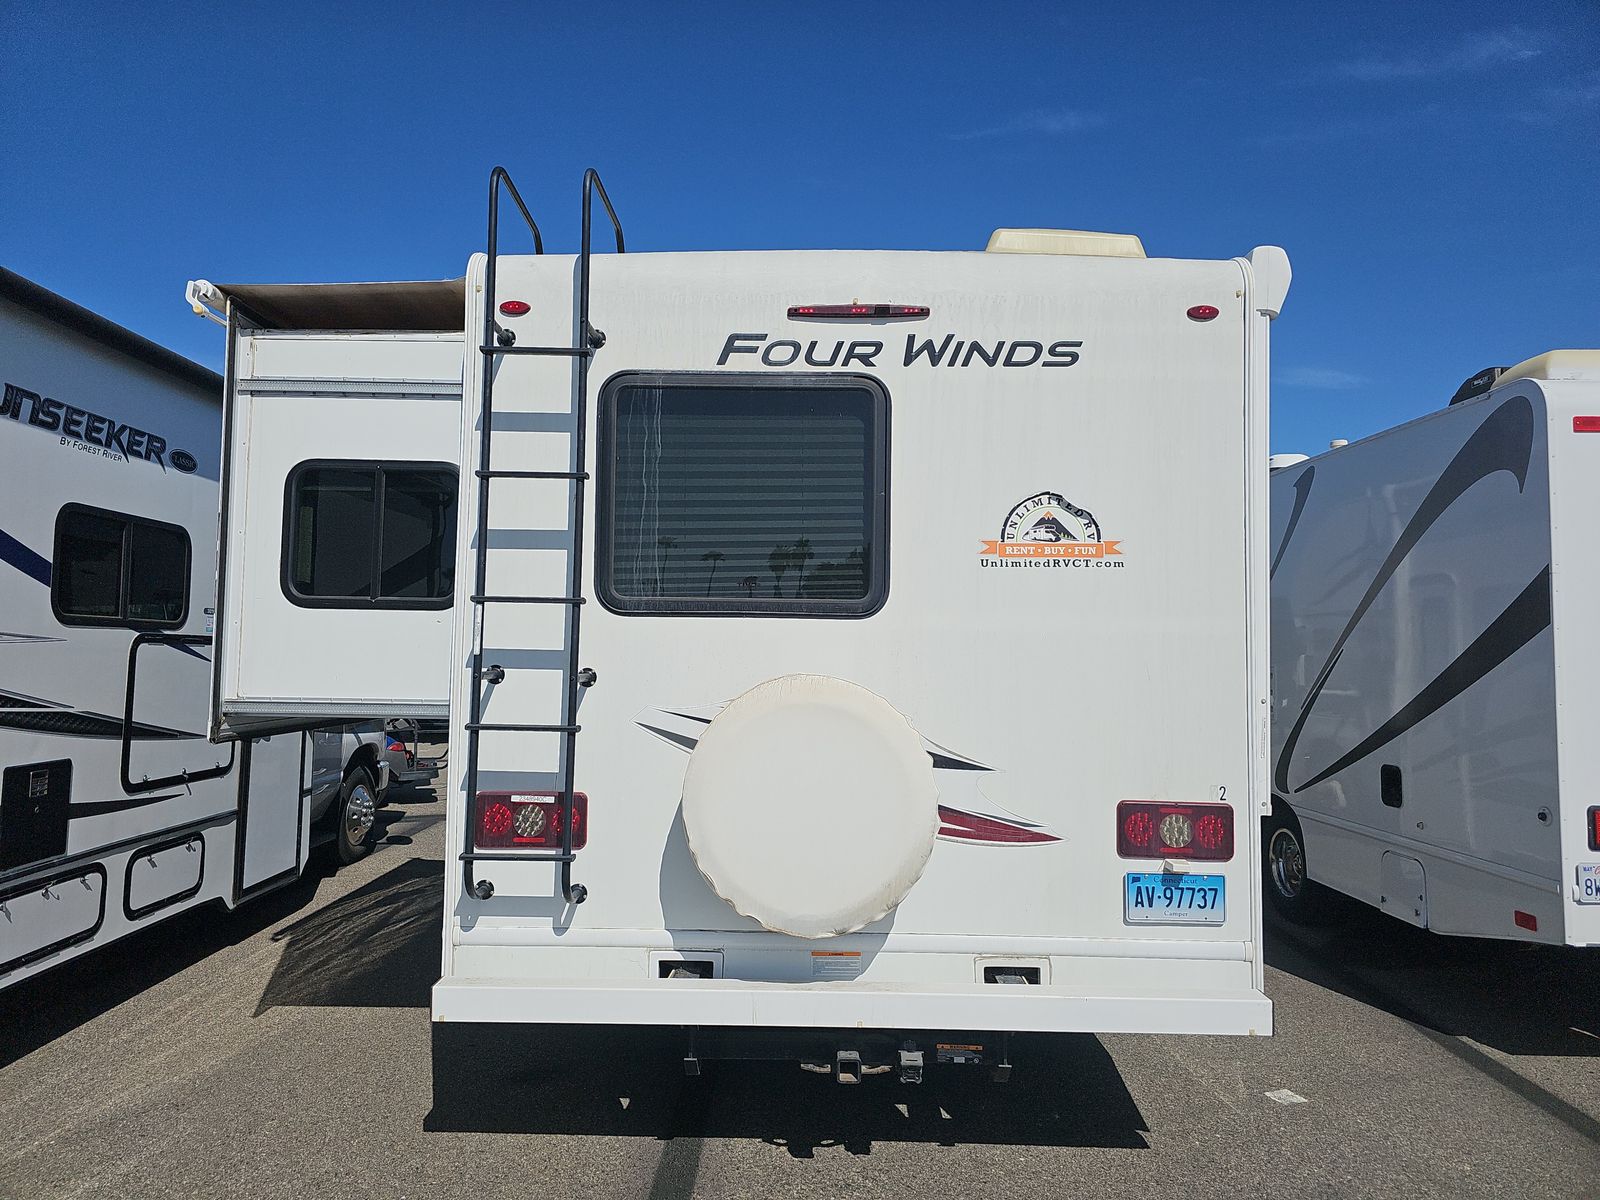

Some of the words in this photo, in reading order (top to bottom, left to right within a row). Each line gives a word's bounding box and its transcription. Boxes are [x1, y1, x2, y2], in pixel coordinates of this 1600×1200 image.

[716, 333, 884, 368] FOUR
[904, 333, 1084, 368] WINDS
[59, 436, 71, 447] BY
[73, 440, 101, 456] FOREST
[102, 449, 123, 463] RIVER
[1006, 496, 1085, 540] UNLIMITED
[1083, 519, 1096, 540] RV
[1005, 546, 1036, 555] RENT
[1043, 546, 1066, 555] BUY
[1074, 546, 1097, 555] FUN
[980, 558, 1125, 568] UnlimitedRVCT.com
[1219, 786, 1227, 801] 2
[1163, 910, 1188, 918] Camper
